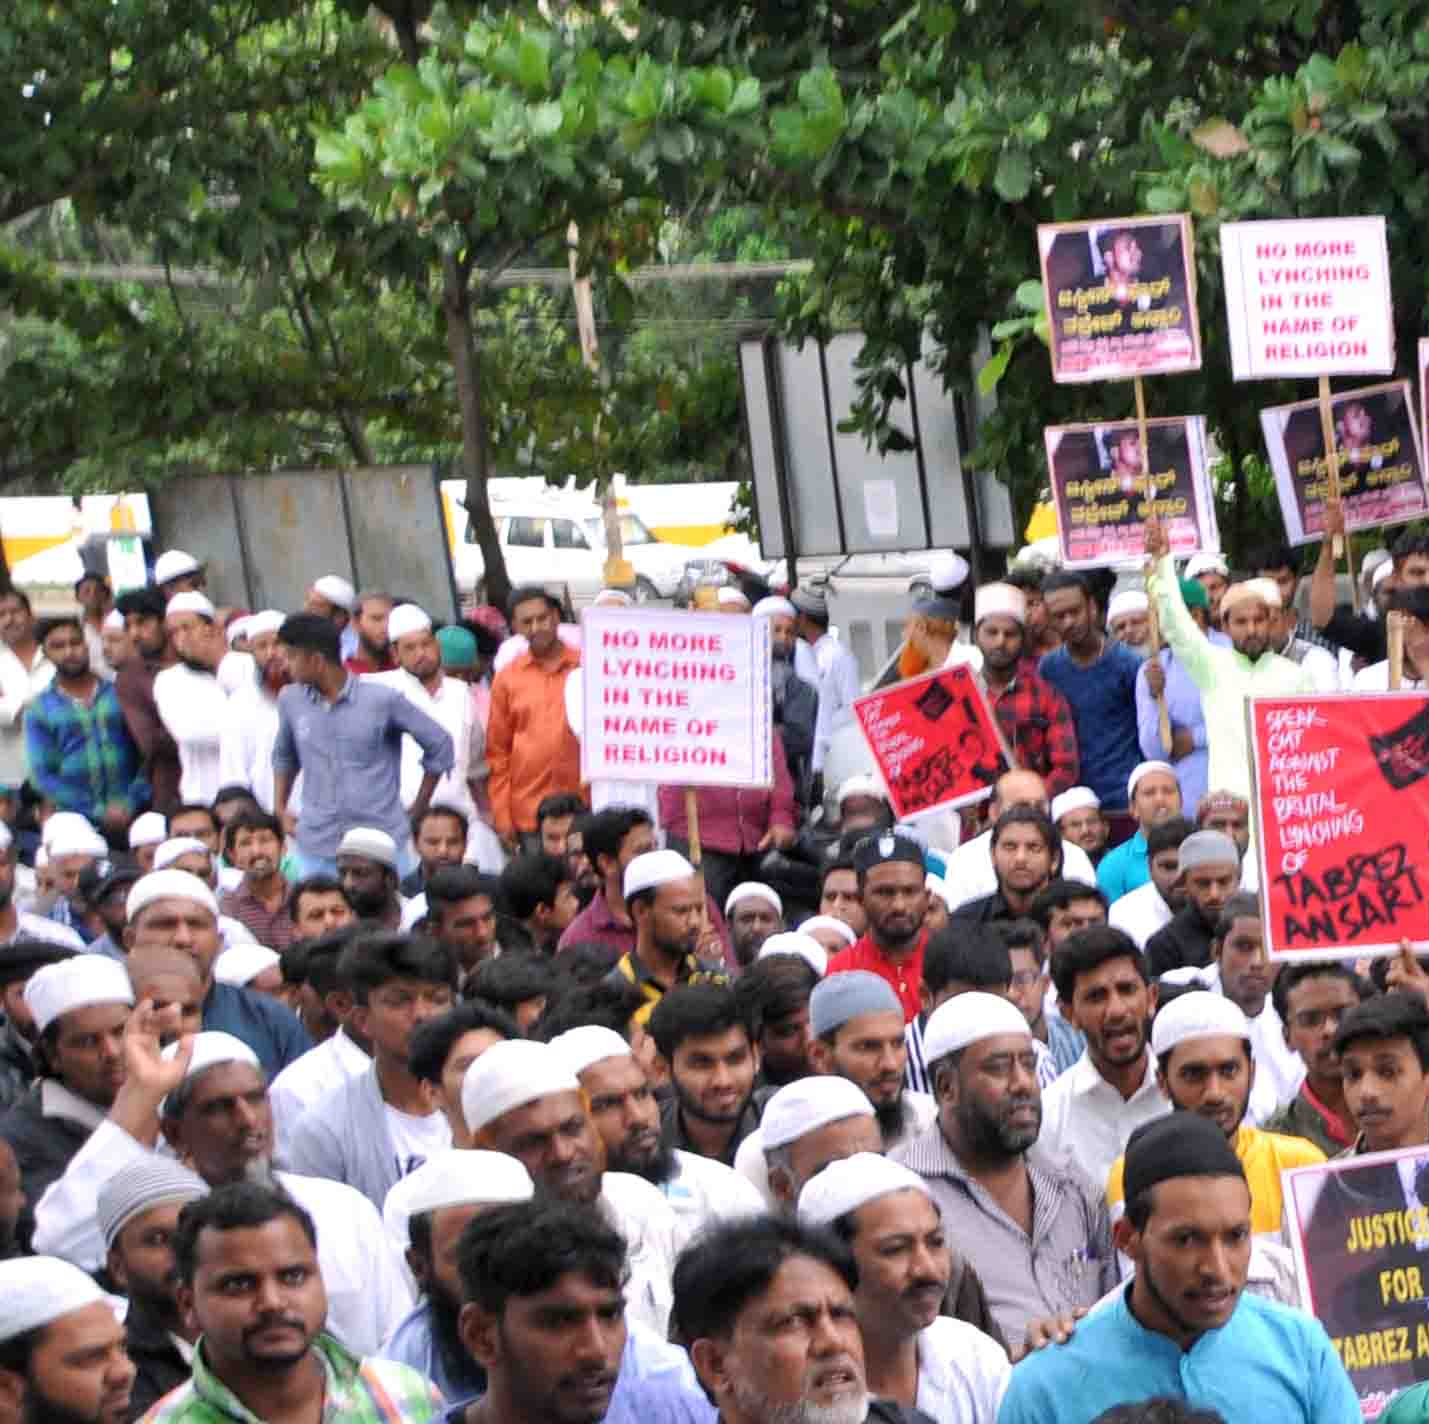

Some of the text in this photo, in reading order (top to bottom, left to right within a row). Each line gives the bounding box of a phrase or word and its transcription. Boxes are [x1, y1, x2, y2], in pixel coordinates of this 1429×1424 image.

[1256, 240, 1356, 258] NO MORE
[1258, 264, 1370, 285] LYNCHING
[1260, 291, 1333, 311] IN THE
[1263, 315, 1360, 336] NAME OF
[1265, 340, 1368, 361] RELIGION
[603, 630, 723, 652] NO MORE
[603, 659, 736, 683] LYNCHING
[603, 688, 689, 707] IN THE
[603, 716, 720, 736] NAME OF
[603, 744, 727, 765] RELIGION
[1281, 850, 1309, 876] OF
[1274, 843, 1407, 908] TABREZ
[1284, 866, 1424, 944] ANSARI
[1379, 1265, 1425, 1307] FOR
